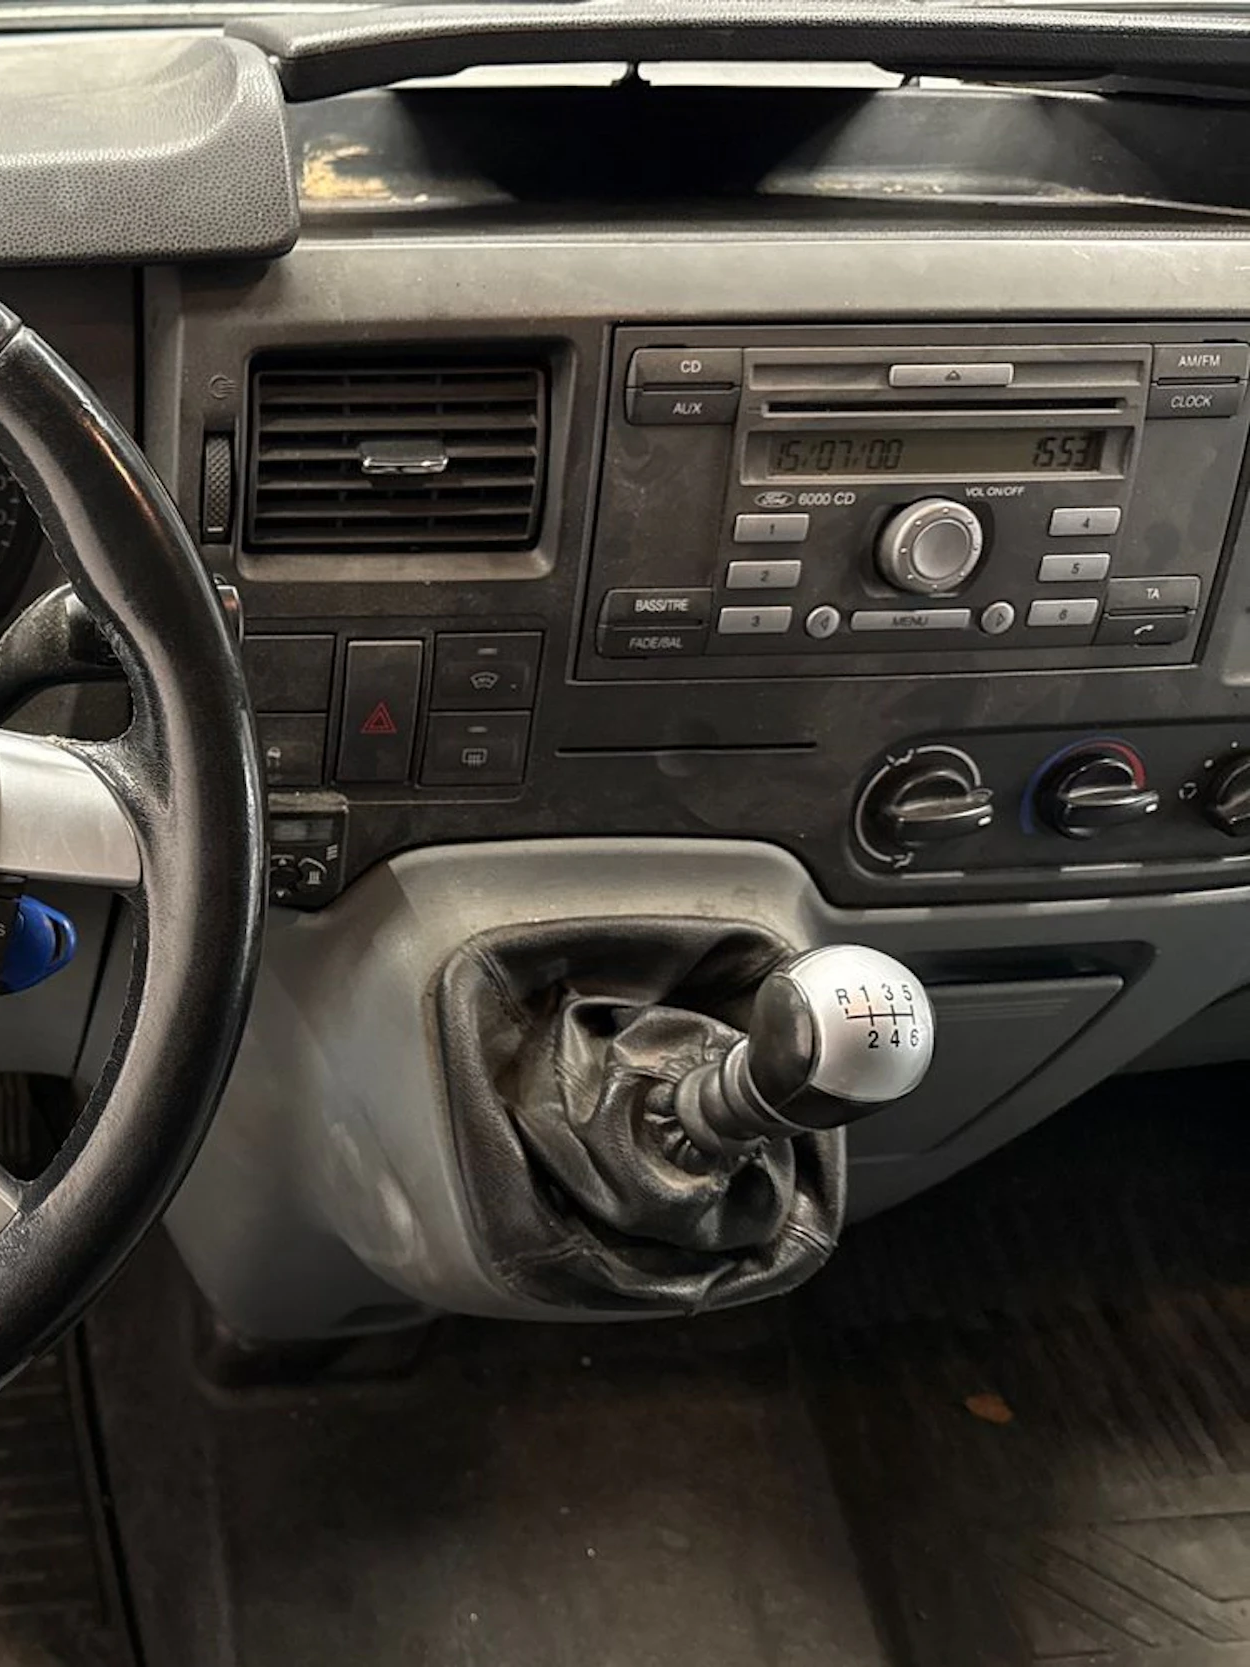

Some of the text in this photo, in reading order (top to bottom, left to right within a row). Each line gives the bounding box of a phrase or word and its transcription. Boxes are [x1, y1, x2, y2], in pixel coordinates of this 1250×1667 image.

[680, 360, 701, 373] CD
[1178, 354, 1221, 367] AM/FM
[1171, 395, 1213, 408] CLOCK
[673, 403, 701, 415] AUX
[965, 486, 985, 497] VOL
[798, 492, 831, 506] 6000
[834, 491, 856, 505] CD
[768, 523, 776, 535] 1
[1082, 518, 1091, 529] 4
[1071, 563, 1080, 574] 5
[760, 570, 770, 582] 2
[1146, 588, 1160, 600] TA
[634, 598, 690, 613] BASS/TRE
[1059, 609, 1068, 621] 6
[751, 616, 761, 628] 3
[629, 636, 683, 650] FADE/BAL
[835, 983, 913, 1005] R 1 3 5
[868, 1028, 919, 1049] 2 4 6
